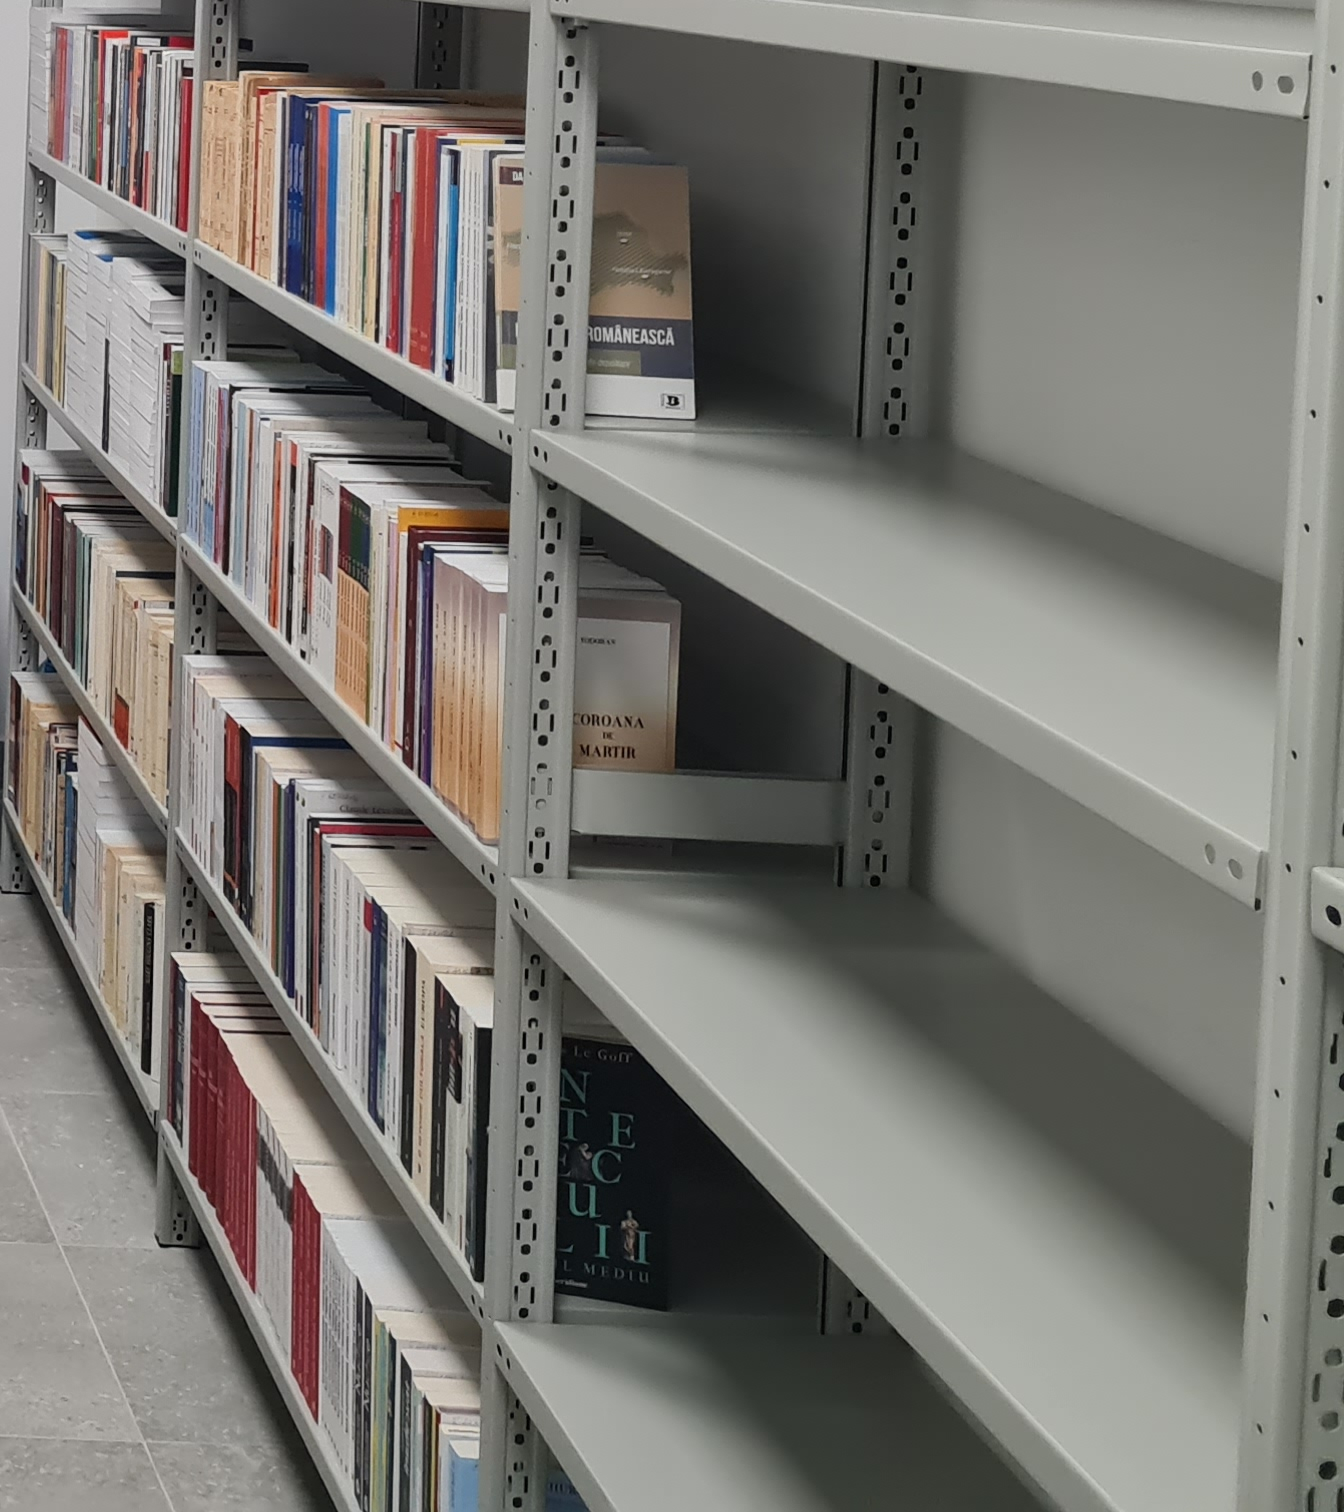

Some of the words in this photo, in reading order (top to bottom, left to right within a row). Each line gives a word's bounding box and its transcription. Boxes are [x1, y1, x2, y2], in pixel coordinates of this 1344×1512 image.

[587, 325, 675, 346] ROMÂNEASCĂ
[573, 713, 645, 729] COROANA
[579, 744, 636, 759] MARTIR
